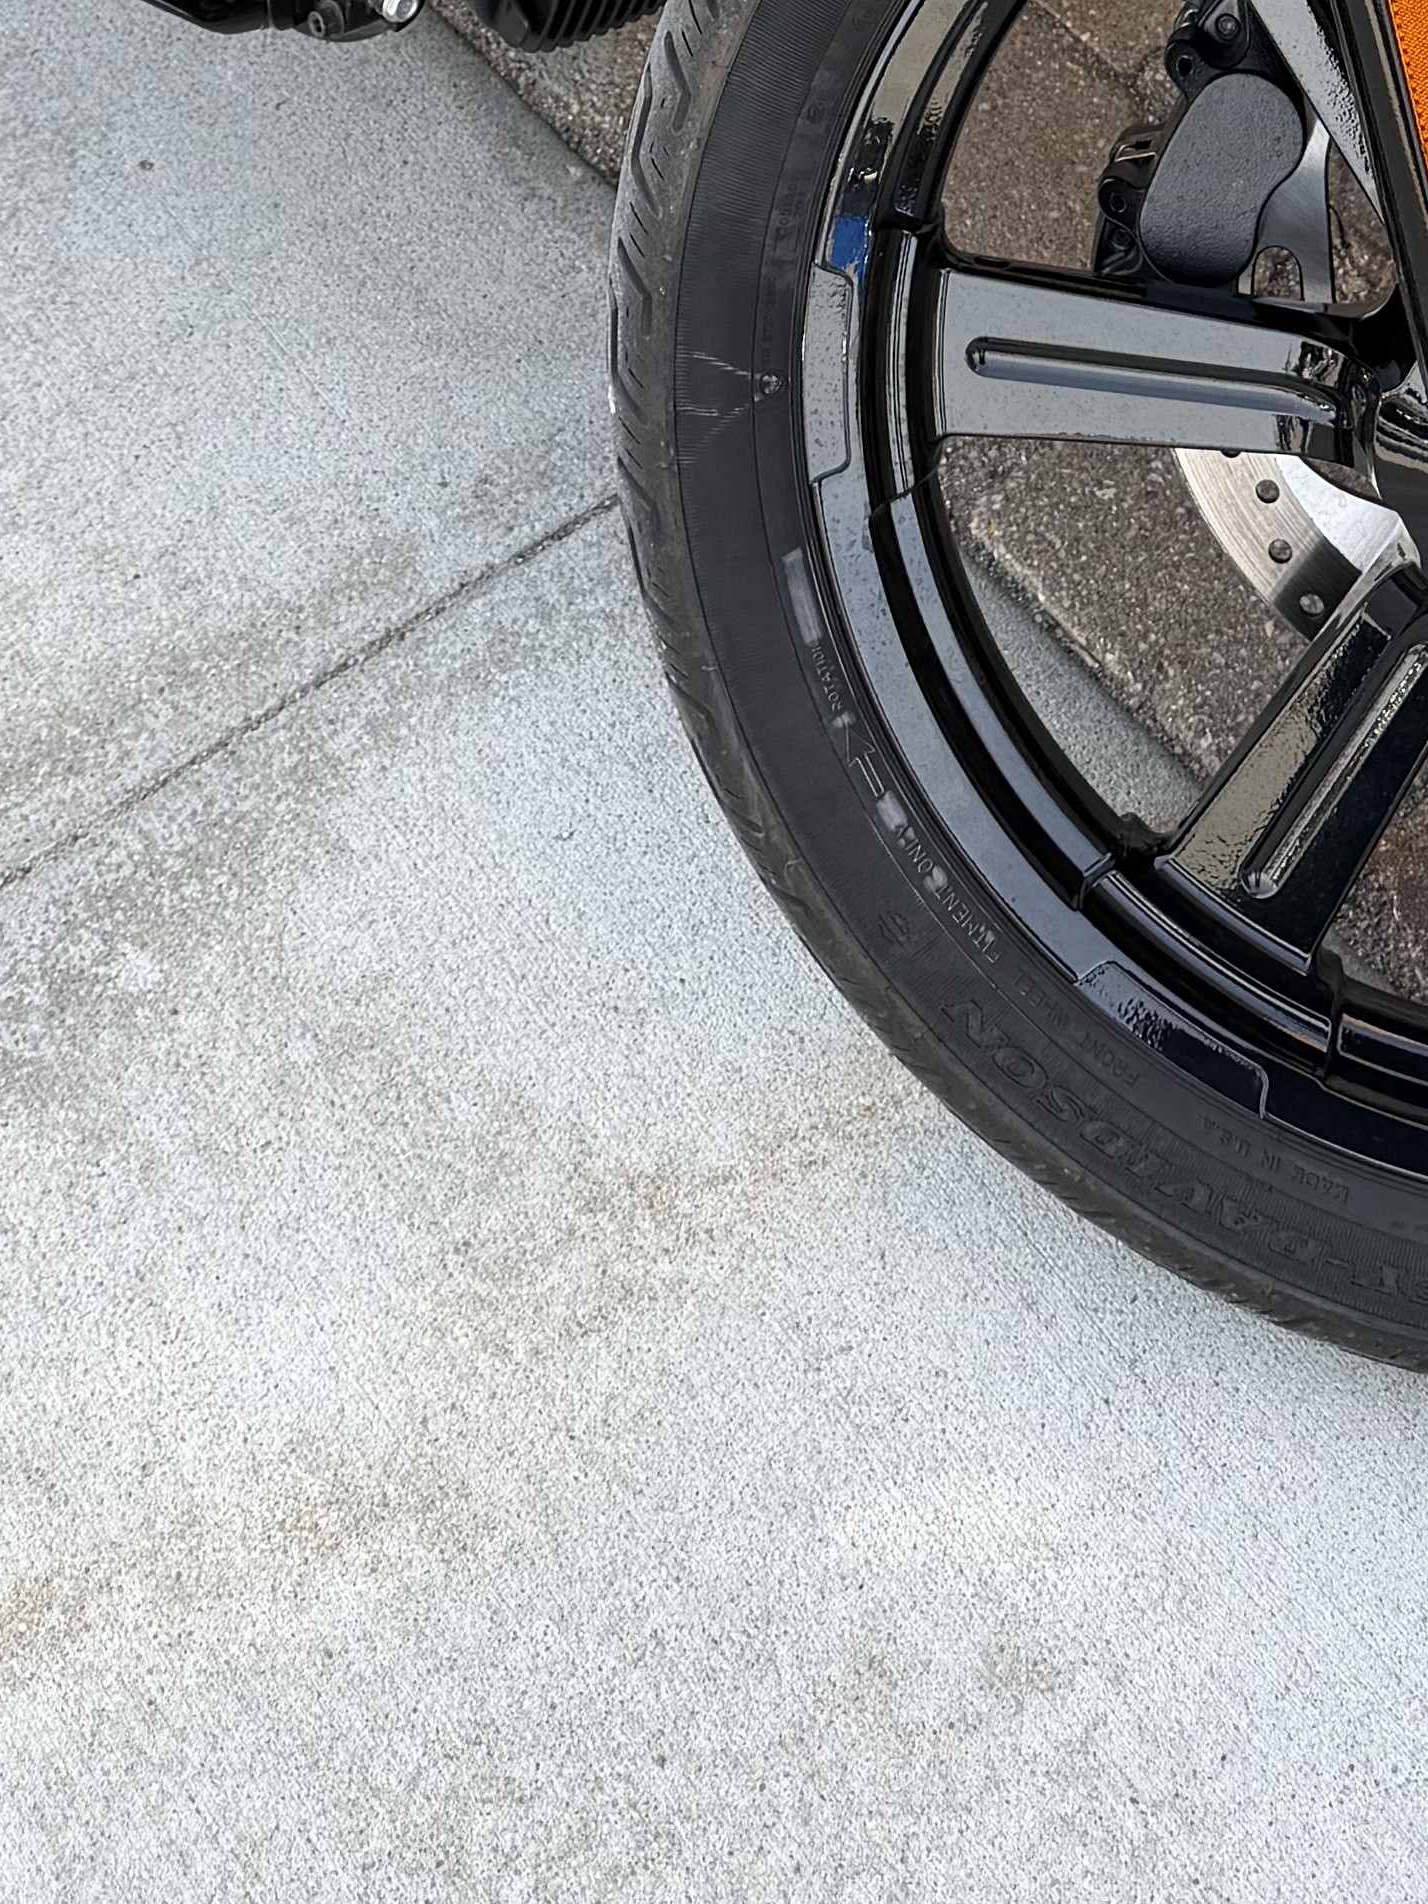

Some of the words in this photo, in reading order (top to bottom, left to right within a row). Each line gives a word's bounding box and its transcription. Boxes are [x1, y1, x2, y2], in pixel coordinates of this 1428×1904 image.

[802, 637, 848, 713] ROTATION
[886, 817, 939, 877] ONLY
[930, 879, 1009, 965] FITMENT
[1006, 966, 1074, 1031] WHEEL
[1073, 1027, 1145, 1089] FRONT
[1287, 1162, 1354, 1206] MADE
